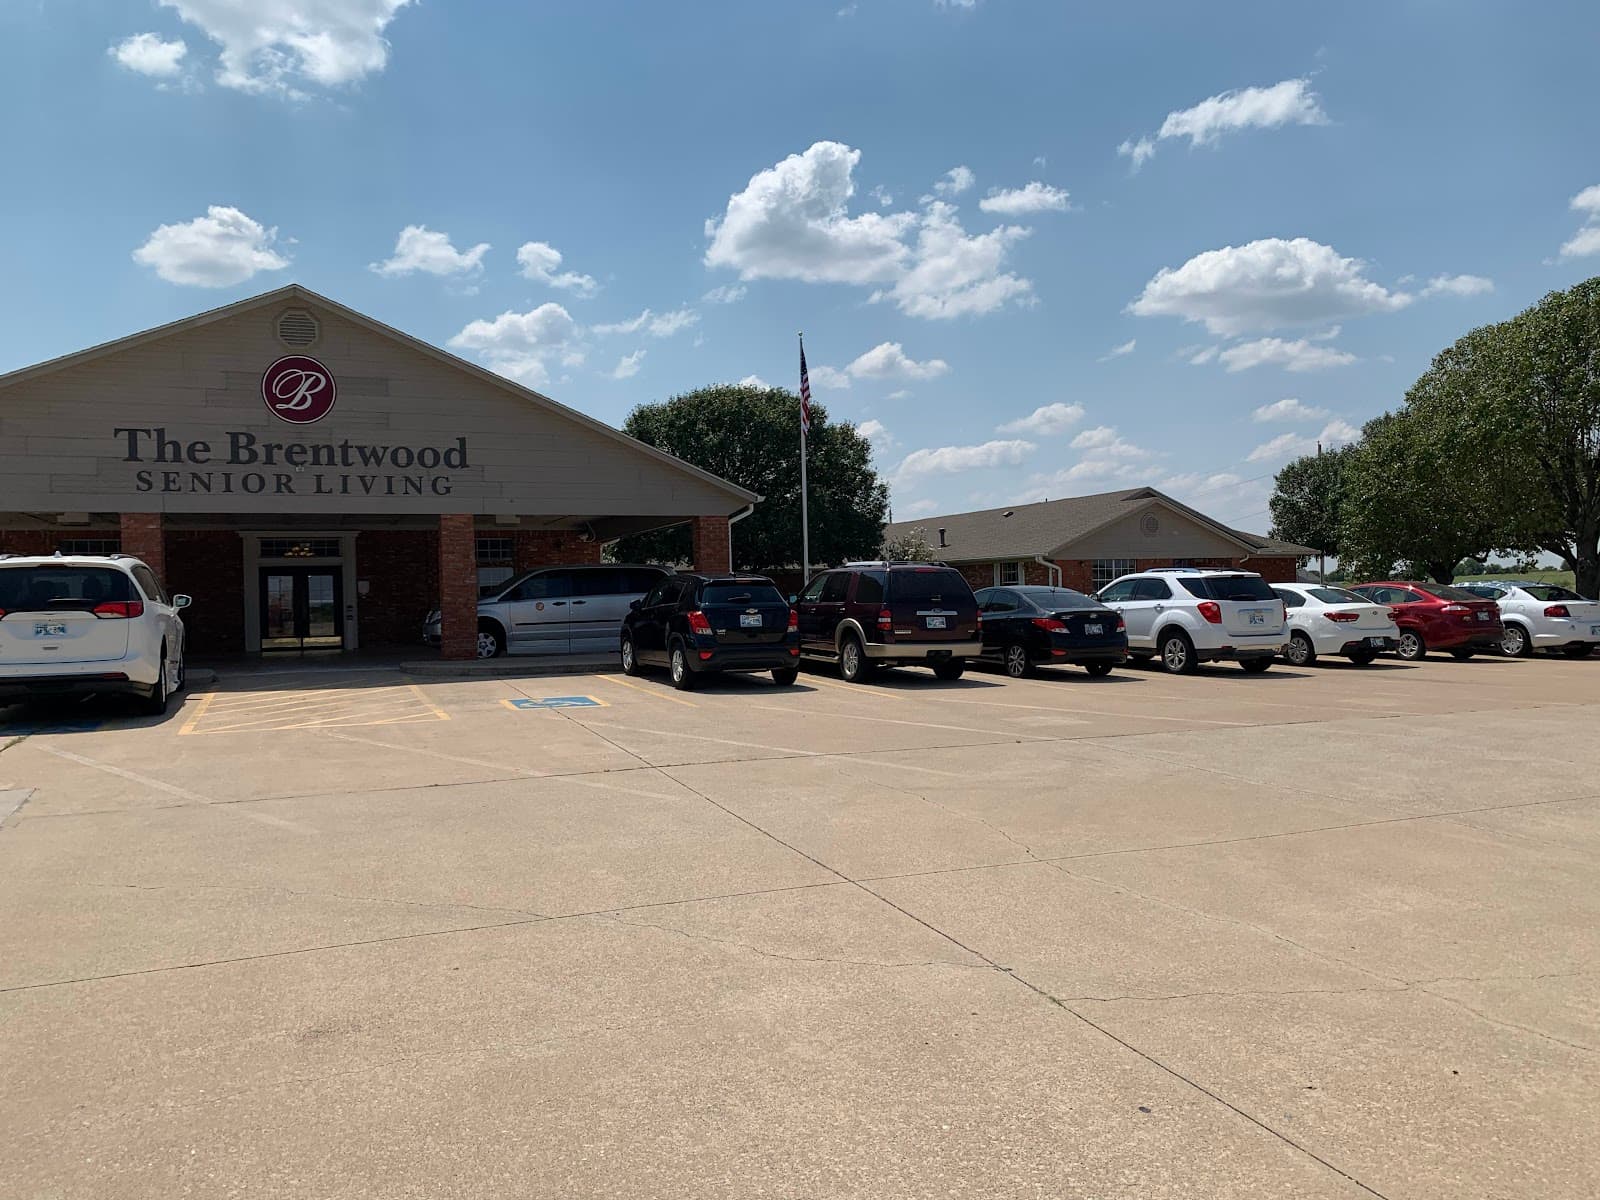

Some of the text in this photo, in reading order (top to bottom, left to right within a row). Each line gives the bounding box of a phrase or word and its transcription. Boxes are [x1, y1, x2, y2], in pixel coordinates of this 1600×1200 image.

[272, 368, 327, 411] B
[114, 427, 470, 470] The Brentwood
[136, 470, 453, 496] SENIOR LIVING
